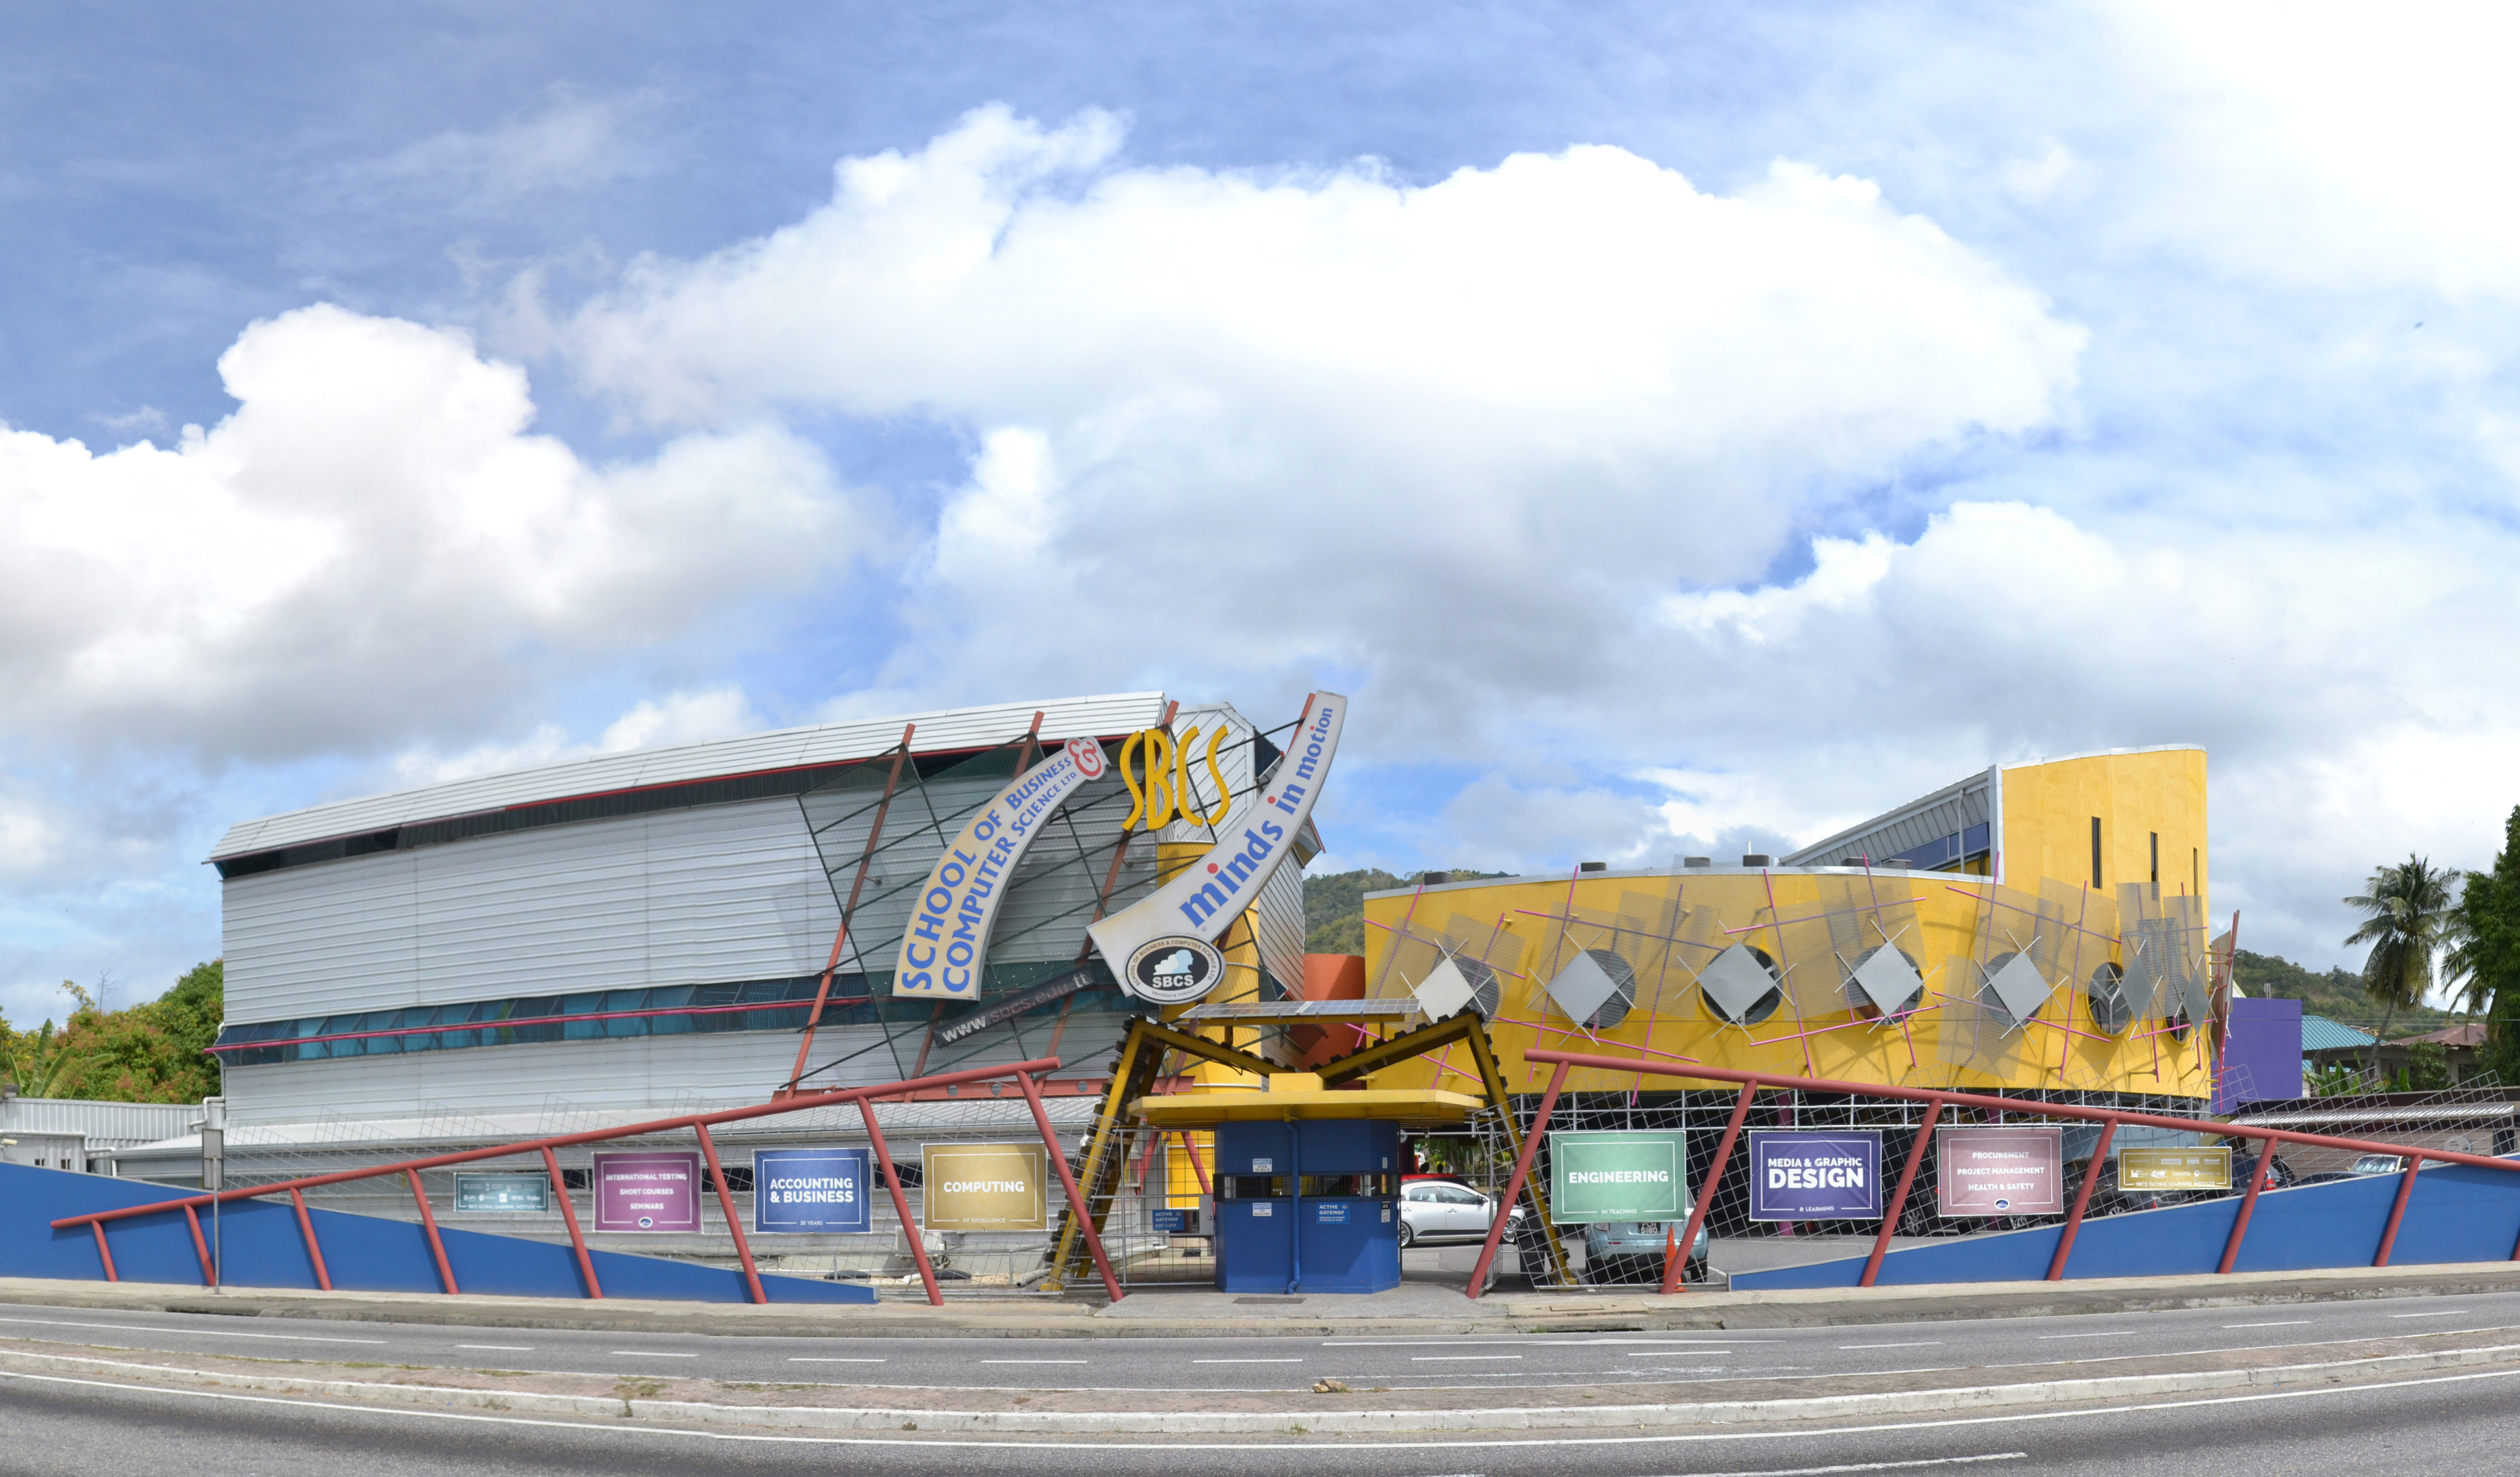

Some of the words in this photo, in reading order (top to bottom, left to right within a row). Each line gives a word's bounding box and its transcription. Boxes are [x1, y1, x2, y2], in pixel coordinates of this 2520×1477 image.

[1120, 725, 1231, 831] SBCS
[1179, 820, 1283, 928] minds
[1267, 784, 1306, 815] in
[1296, 708, 1333, 780] motion
[901, 849, 977, 990] SCHOOL
[974, 809, 1002, 840] OF
[1005, 757, 1071, 810] BUSINESS
[1068, 740, 1101, 777] &
[942, 836, 1017, 992] COMPUTER
[1011, 784, 1061, 837] SCIENCE
[1060, 772, 1078, 786] LTD.
[1130, 964, 1141, 986] SCHOOL
[1139, 941, 1164, 957] BUSINESS
[1171, 940, 1202, 950] COMPUTER
[1201, 947, 1217, 968] SCIENCE
[1152, 974, 1194, 988] SBCS
[1177, 988, 1196, 997] TOBAGO
[941, 972, 1090, 1042] www.sbcs.edu.tt
[1768, 1158, 1802, 1167] MEDIA
[1804, 1158, 1812, 1167] &
[1814, 1157, 1862, 1166] GRAPHIC
[769, 1178, 853, 1190] ACCOUNTING
[1569, 1170, 1669, 1183] ENGINEERING
[1769, 1168, 1864, 1189] DESIGN
[943, 1181, 1025, 1192] COMPUTING
[770, 1191, 780, 1203] &
[784, 1190, 853, 1203] BUSINESS
